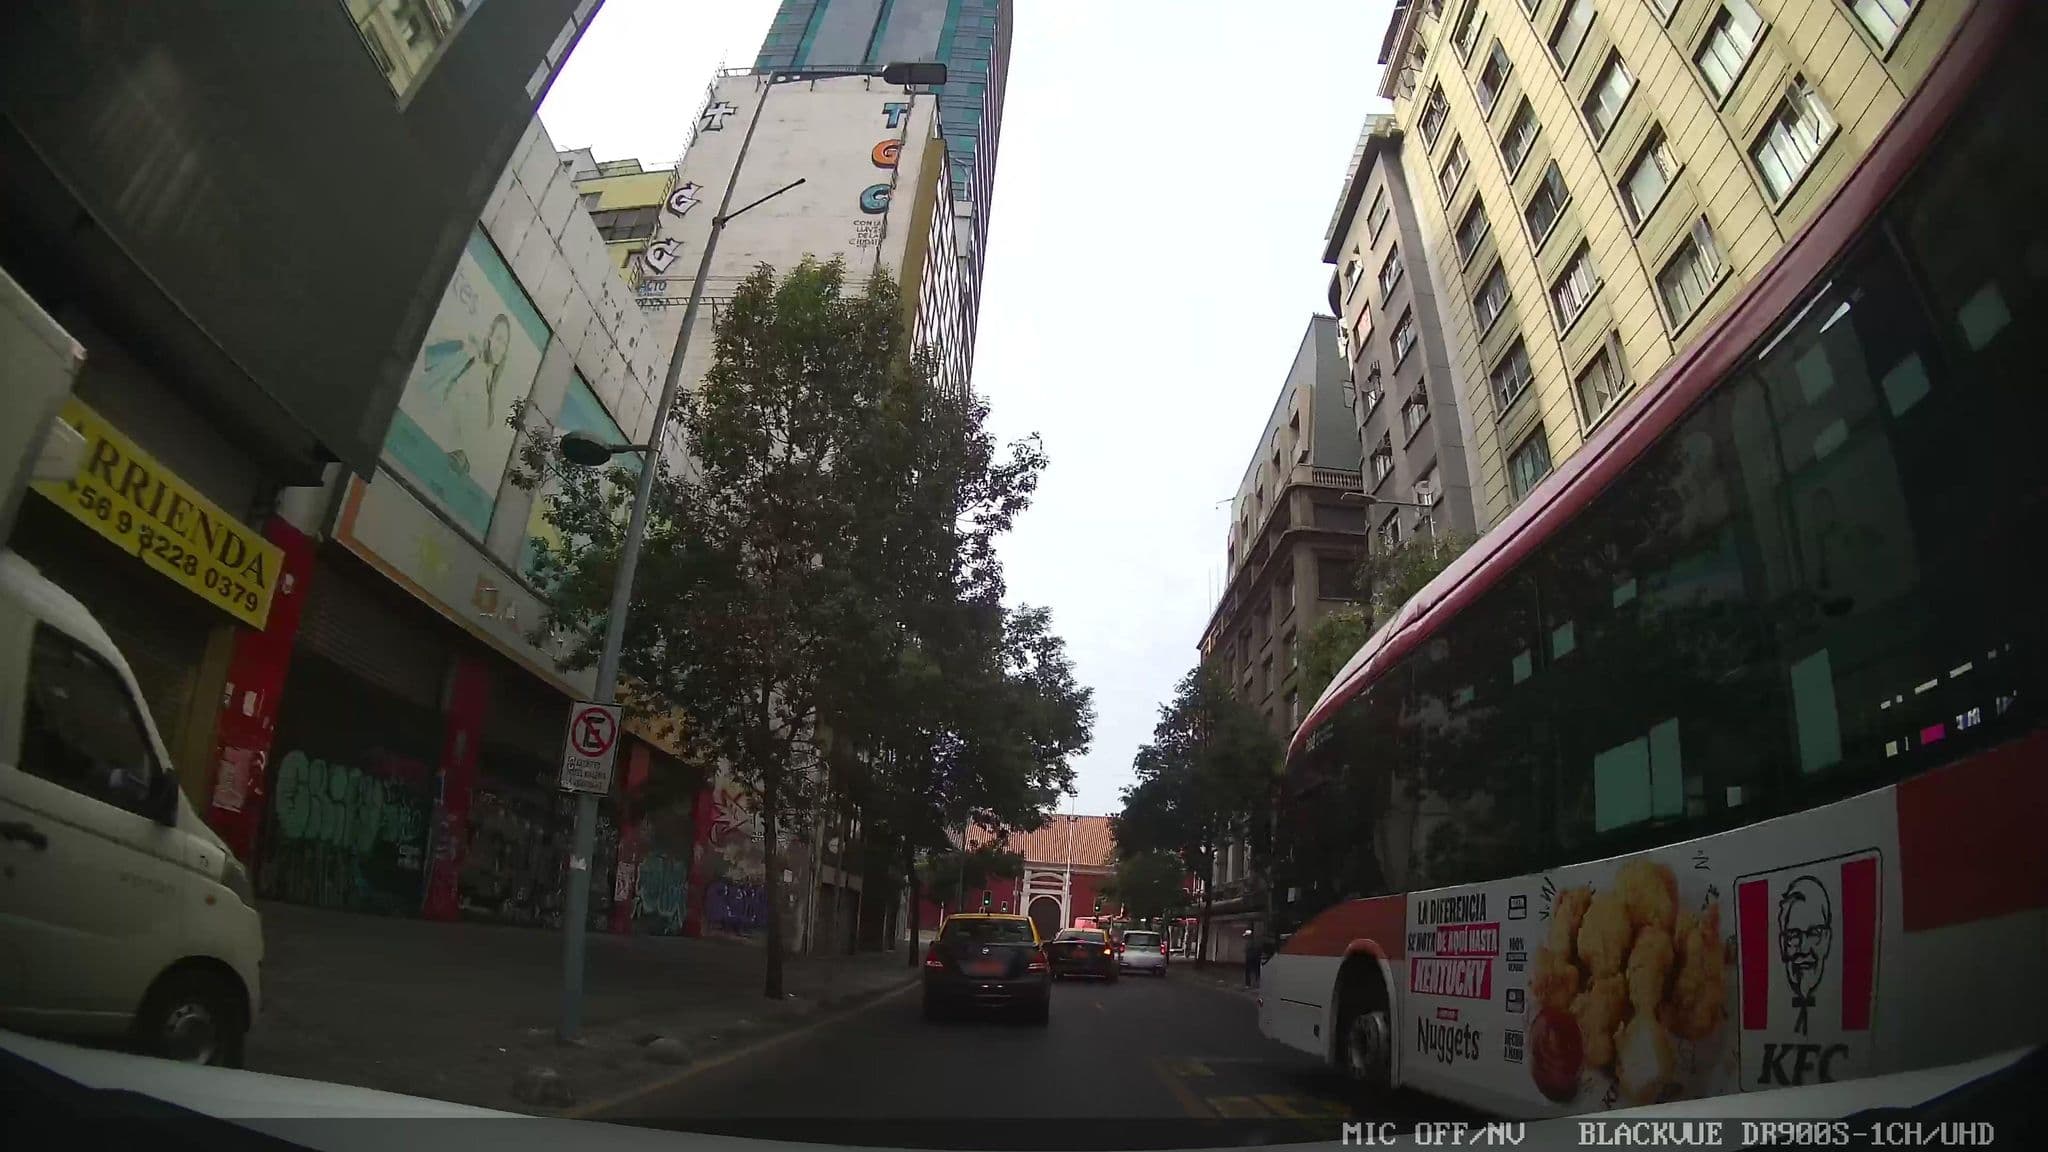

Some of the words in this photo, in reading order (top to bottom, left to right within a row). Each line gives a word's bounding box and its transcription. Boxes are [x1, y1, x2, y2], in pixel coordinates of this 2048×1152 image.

[74, 422, 265, 590] RRIENDA
[116, 510, 132, 534] 9
[205, 567, 258, 612] 0379
[1418, 901, 1428, 924] LA
[1430, 893, 1487, 924] DIFERENCIA
[1416, 931, 1436, 952] NOTA
[1469, 928, 1498, 952] HASTA
[1414, 959, 1488, 997] KENTUCKY
[1417, 1016, 1481, 1065] Nuggets
[1757, 1043, 1850, 1086] KFC
